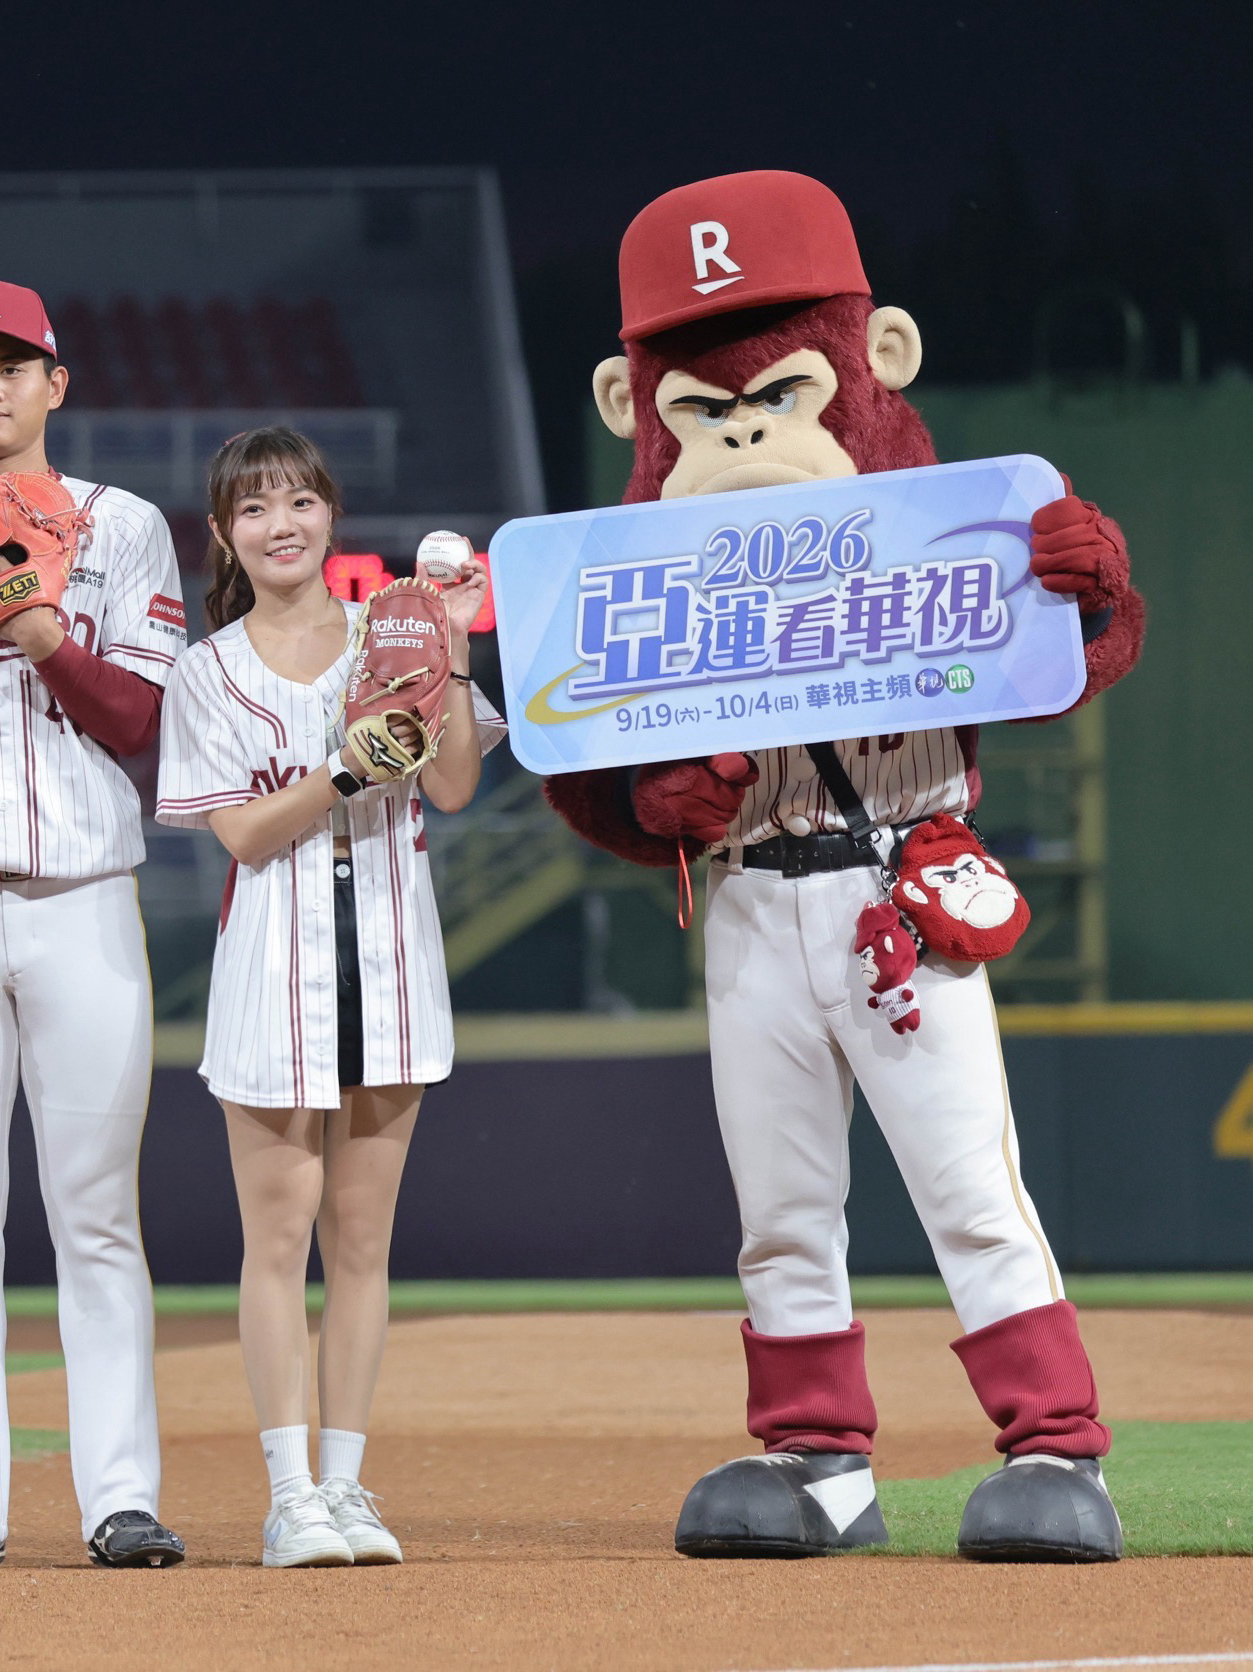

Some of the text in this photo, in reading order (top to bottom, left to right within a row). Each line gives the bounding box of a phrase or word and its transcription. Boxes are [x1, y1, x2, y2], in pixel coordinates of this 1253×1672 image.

[690, 220, 742, 280] R
[703, 509, 873, 588] 2026
[0, 573, 37, 598] ZETT
[370, 615, 436, 636] Rakuten
[375, 637, 424, 649] MONKEYS
[569, 556, 1014, 698] 亞運看華視
[806, 673, 912, 709] 華視主頻
[948, 671, 972, 690] CTS
